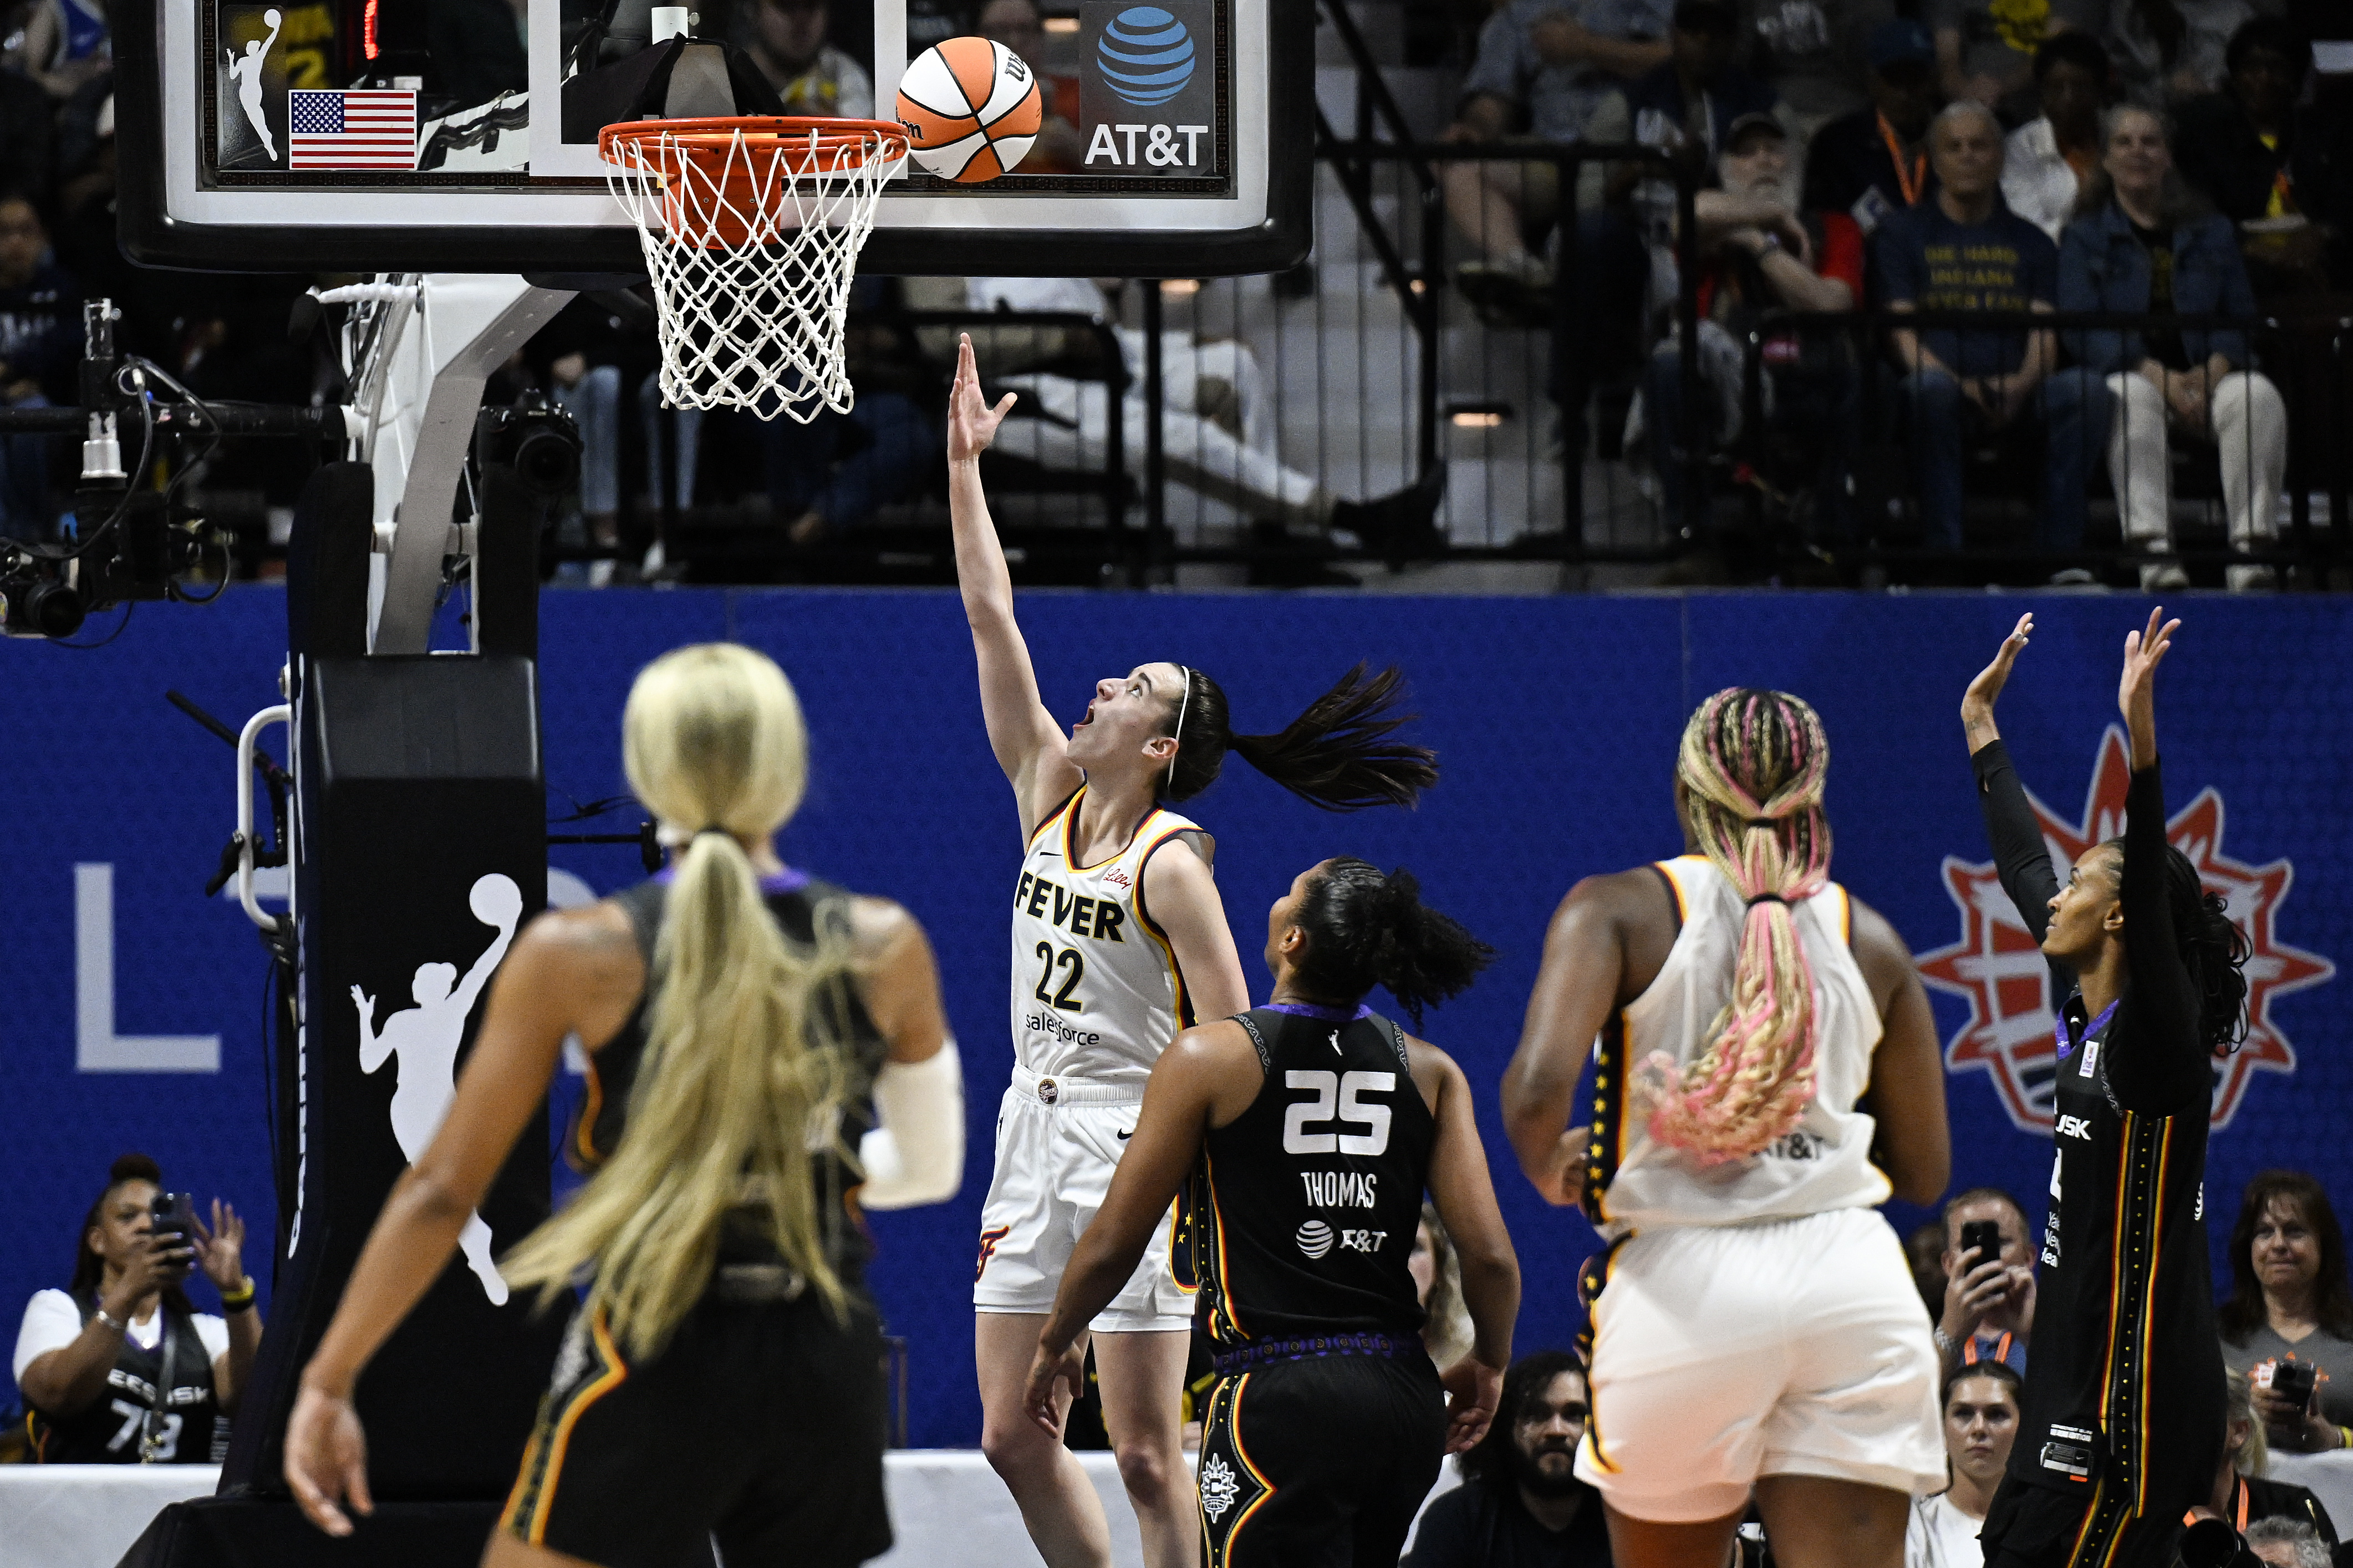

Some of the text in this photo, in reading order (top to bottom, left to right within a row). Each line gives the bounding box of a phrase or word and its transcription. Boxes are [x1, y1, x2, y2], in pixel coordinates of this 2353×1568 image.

[1084, 124, 1209, 166] AT&T
[1103, 869, 1132, 889] Lilly
[1015, 871, 1125, 943] FEVER
[1036, 940, 1084, 1013] 22
[1026, 1012, 1099, 1046] salesforce
[1283, 1070, 1396, 1156] 25
[1300, 1172, 1377, 1209] THOMAS
